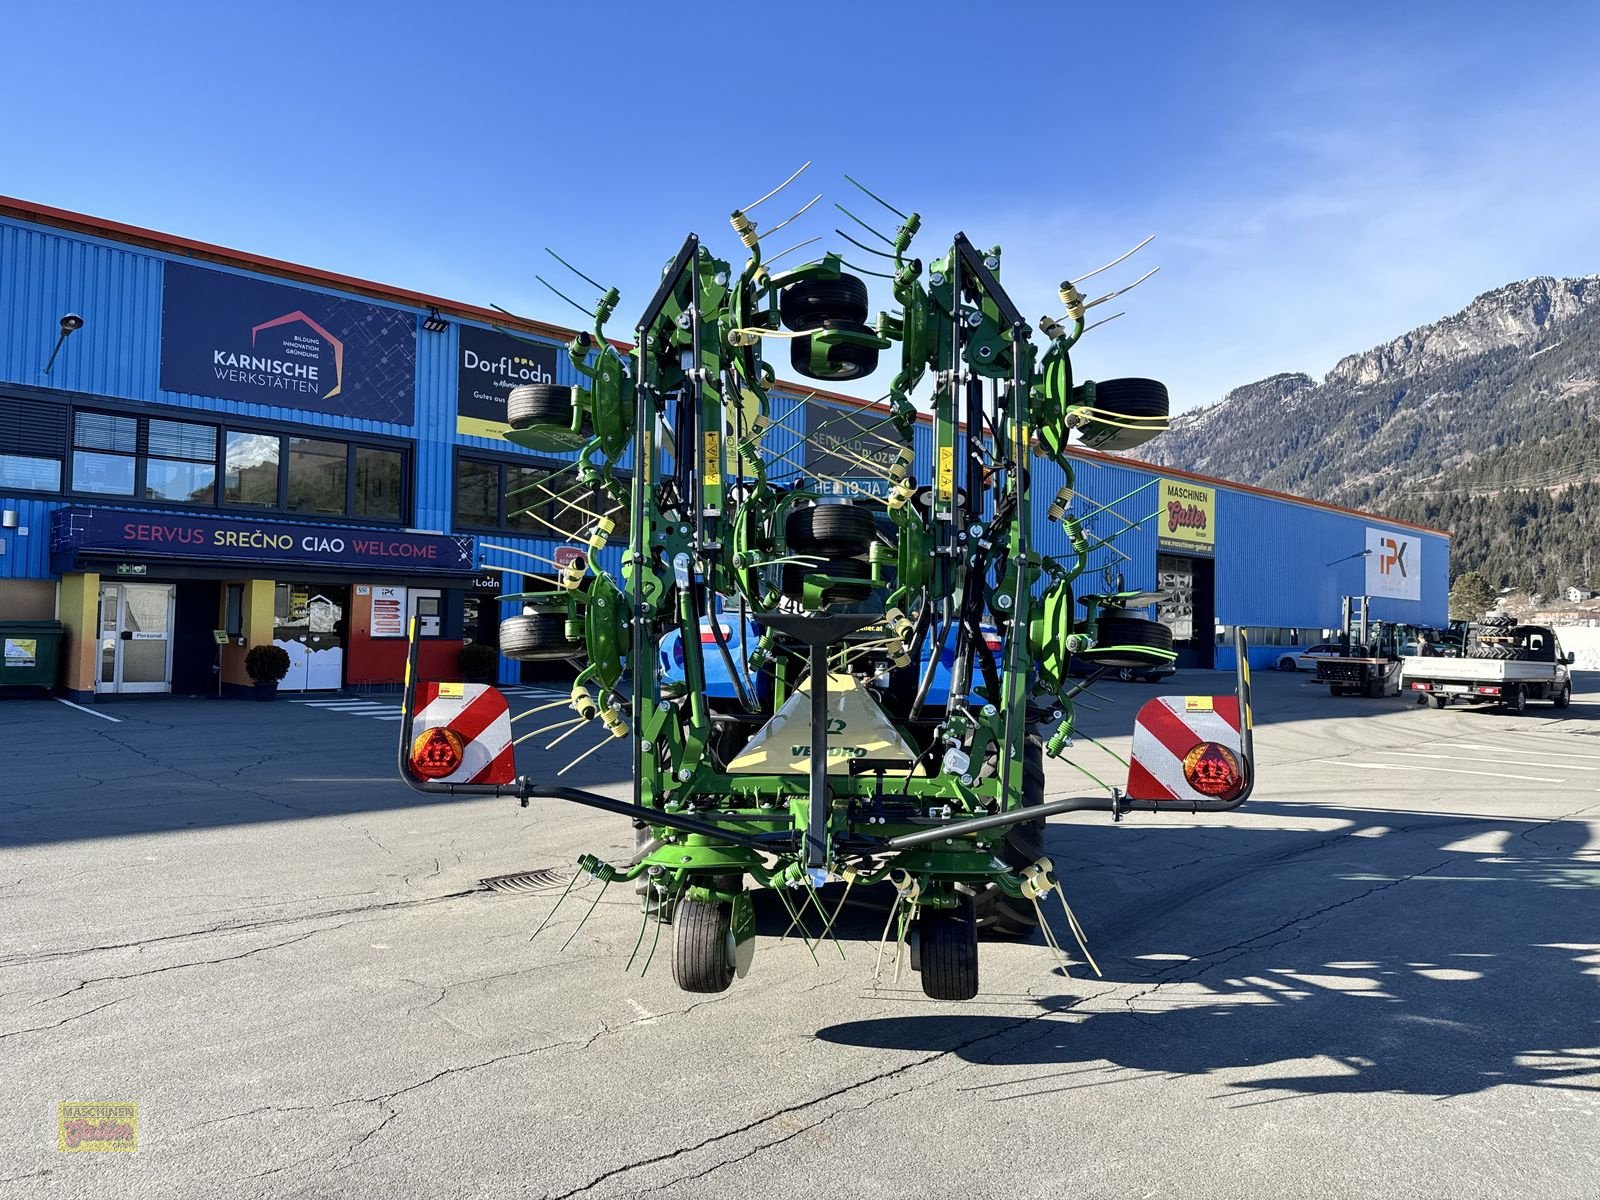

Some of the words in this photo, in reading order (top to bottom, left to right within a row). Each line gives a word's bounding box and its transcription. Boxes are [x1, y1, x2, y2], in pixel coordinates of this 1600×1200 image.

[283, 340, 319, 351] INNOVATION
[294, 335, 319, 345] BILDUNG
[285, 348, 319, 359] GRÜNDUNG
[213, 350, 319, 380] KARNISCHE
[464, 349, 552, 384] DorfLodn
[213, 366, 319, 394] WERKSTÄTTEN
[473, 390, 493, 401] Gutes
[494, 396, 506, 404] aus
[1167, 485, 1208, 503] MASCHINEN
[124, 524, 204, 544] SERVUS
[213, 529, 293, 550] SREČNO
[302, 536, 345, 553] CIAO
[352, 539, 438, 559] WELCOME
[790, 745, 868, 758] VEDRO
